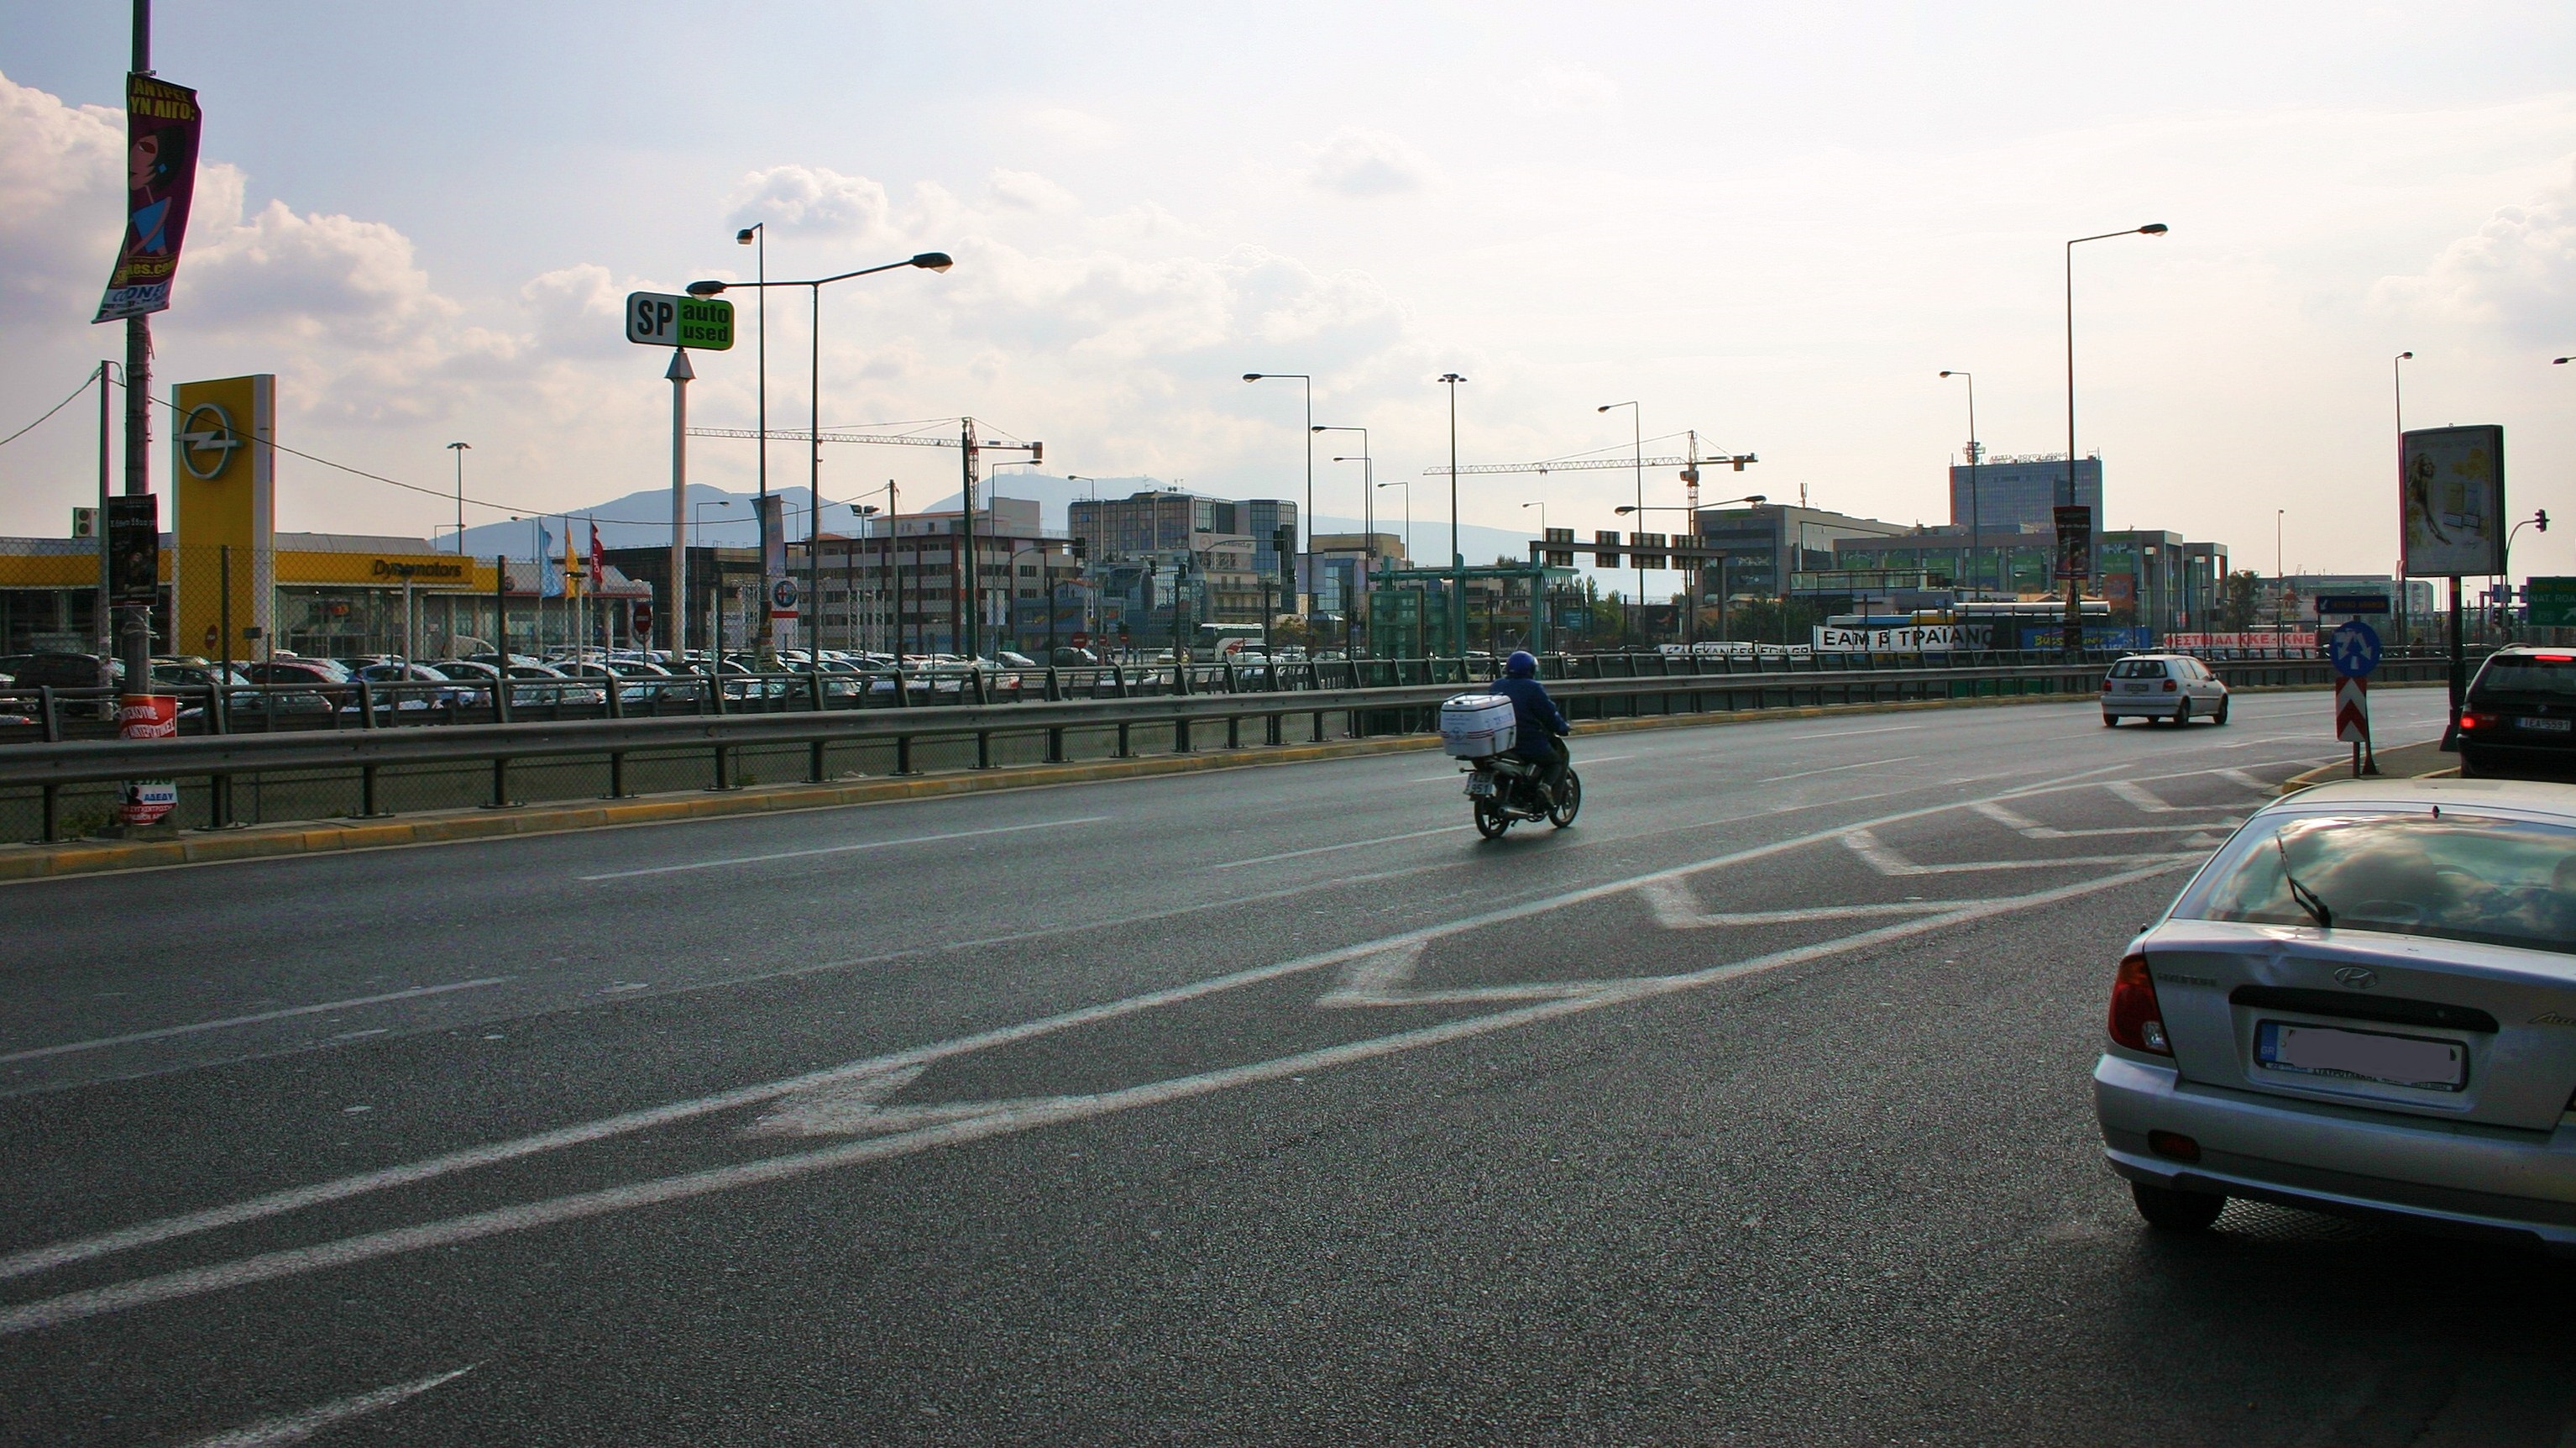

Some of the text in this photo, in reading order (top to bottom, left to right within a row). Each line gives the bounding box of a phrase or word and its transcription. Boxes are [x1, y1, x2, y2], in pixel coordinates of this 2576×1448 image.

[638, 300, 730, 336] SP auto
[683, 325, 728, 342] used
[374, 559, 462, 580] Dynmotors
[2261, 1046, 2275, 1056] GR
